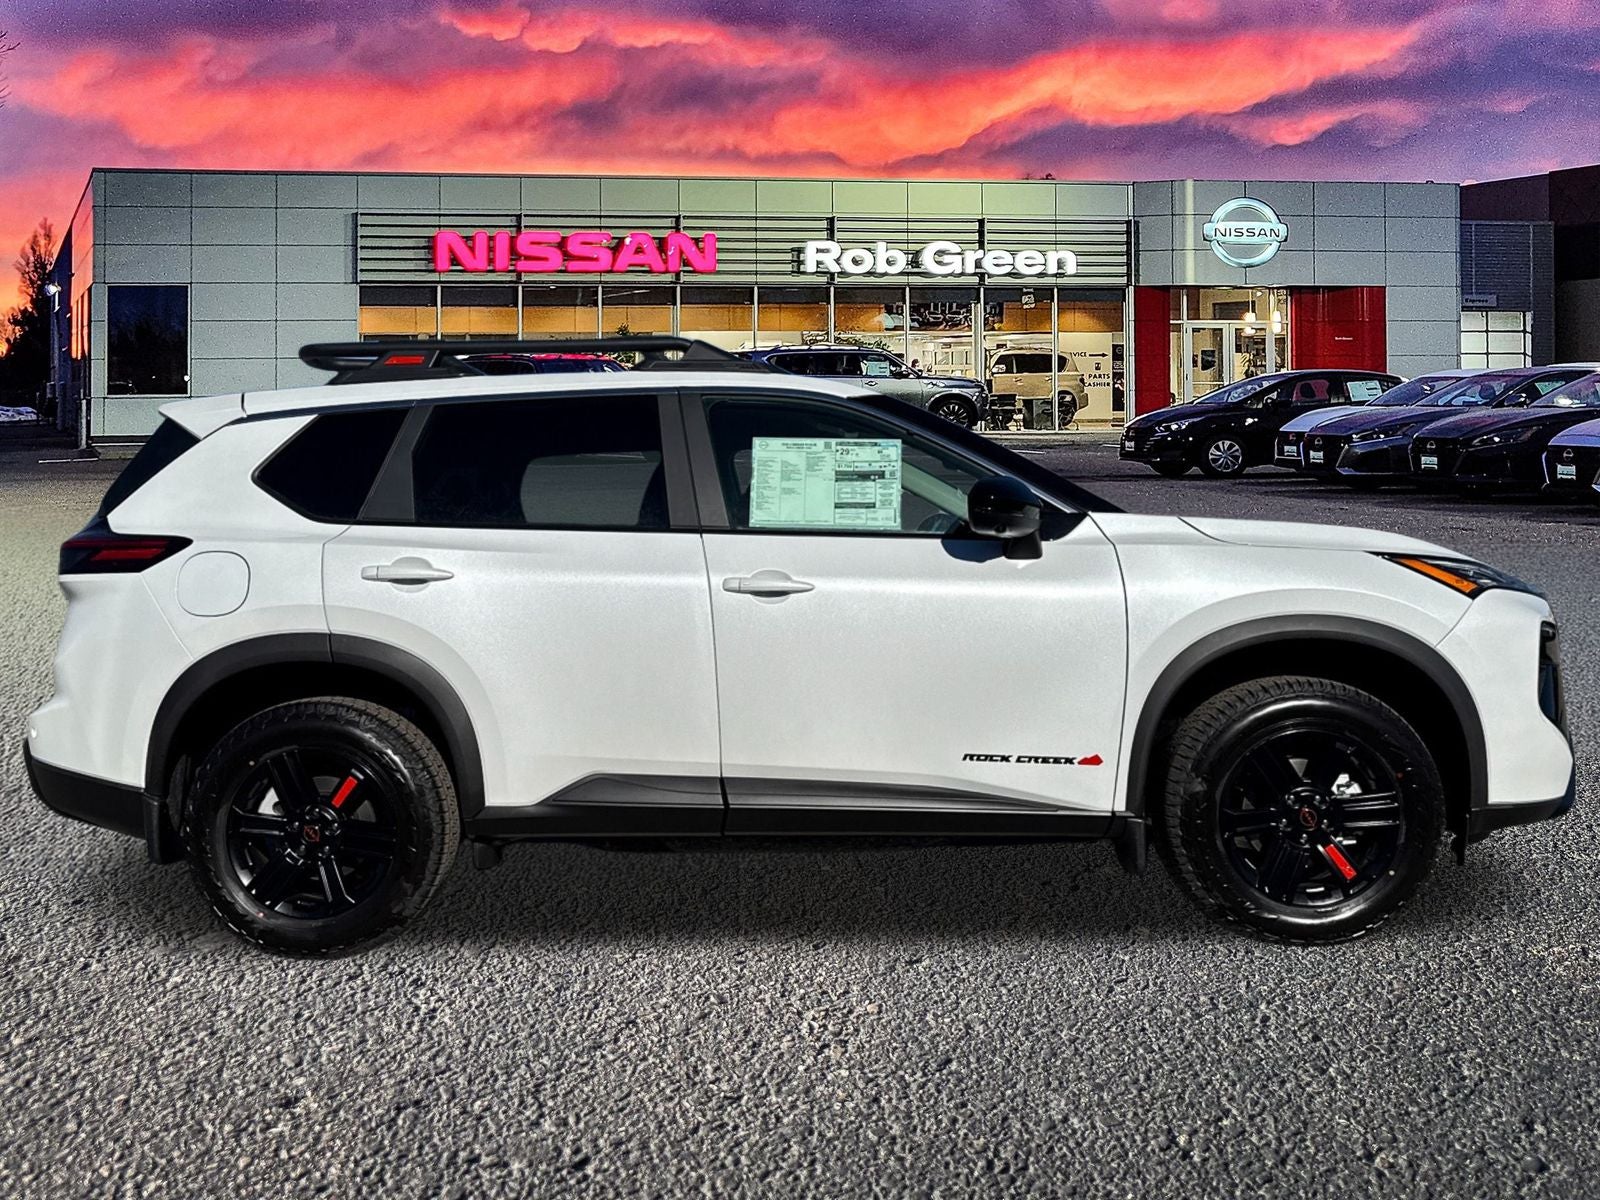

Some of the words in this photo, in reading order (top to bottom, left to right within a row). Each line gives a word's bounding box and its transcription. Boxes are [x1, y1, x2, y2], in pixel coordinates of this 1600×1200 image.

[1214, 227, 1280, 238] NISSAN
[434, 231, 718, 273] NISSAN
[804, 240, 907, 275] Rob
[920, 240, 1078, 275] Green
[962, 753, 1013, 763] ROCK
[1015, 755, 1077, 765] CREEK
